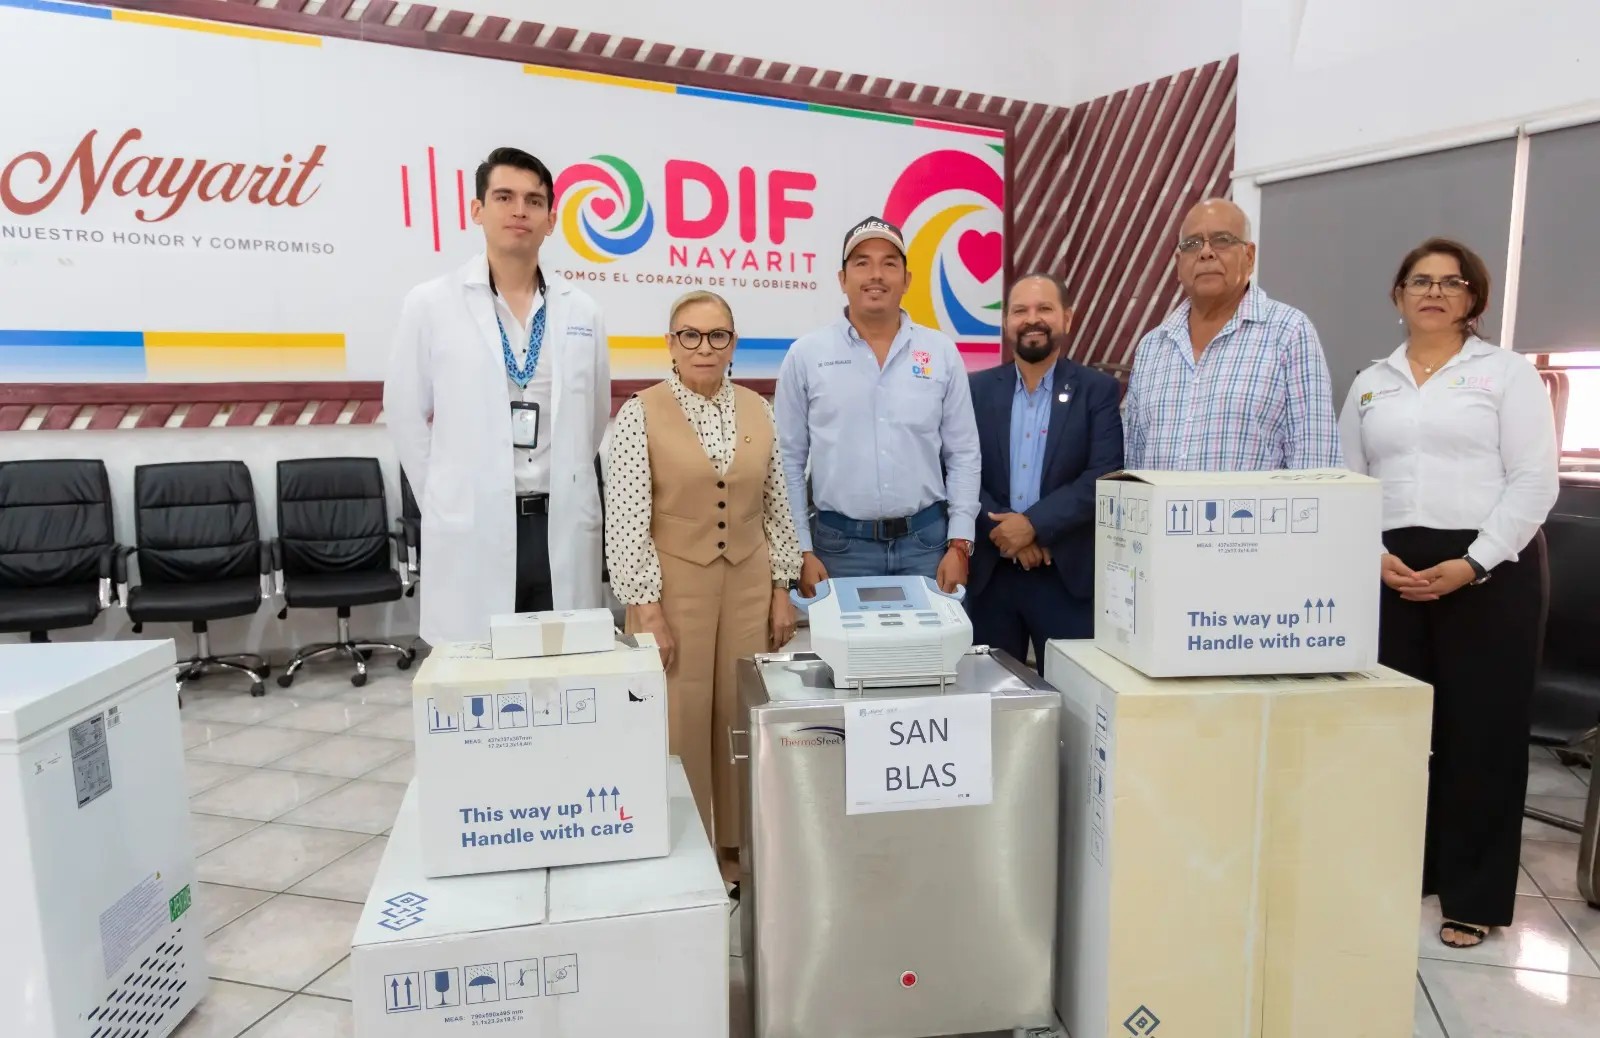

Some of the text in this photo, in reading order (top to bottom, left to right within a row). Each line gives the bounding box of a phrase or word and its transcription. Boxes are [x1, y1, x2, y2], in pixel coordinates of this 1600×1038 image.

[0, 127, 327, 223] Nayarit
[664, 158, 818, 245] DIF
[2, 225, 336, 255] NUESTRO HONOR Y COMPROMISO
[853, 220, 891, 236] GUESS
[669, 244, 818, 274] NAYARIT
[555, 270, 818, 291] OMOS EL CORAZÓN DE TU GOBIERNO
[1187, 611, 1300, 630] This way up
[1187, 633, 1347, 651] Handle with care
[780, 735, 841, 748] ThermoSteel
[888, 717, 949, 746] SAN
[885, 762, 957, 792] BLAS
[459, 802, 582, 824] This way up
[461, 821, 634, 848] Handle with care
